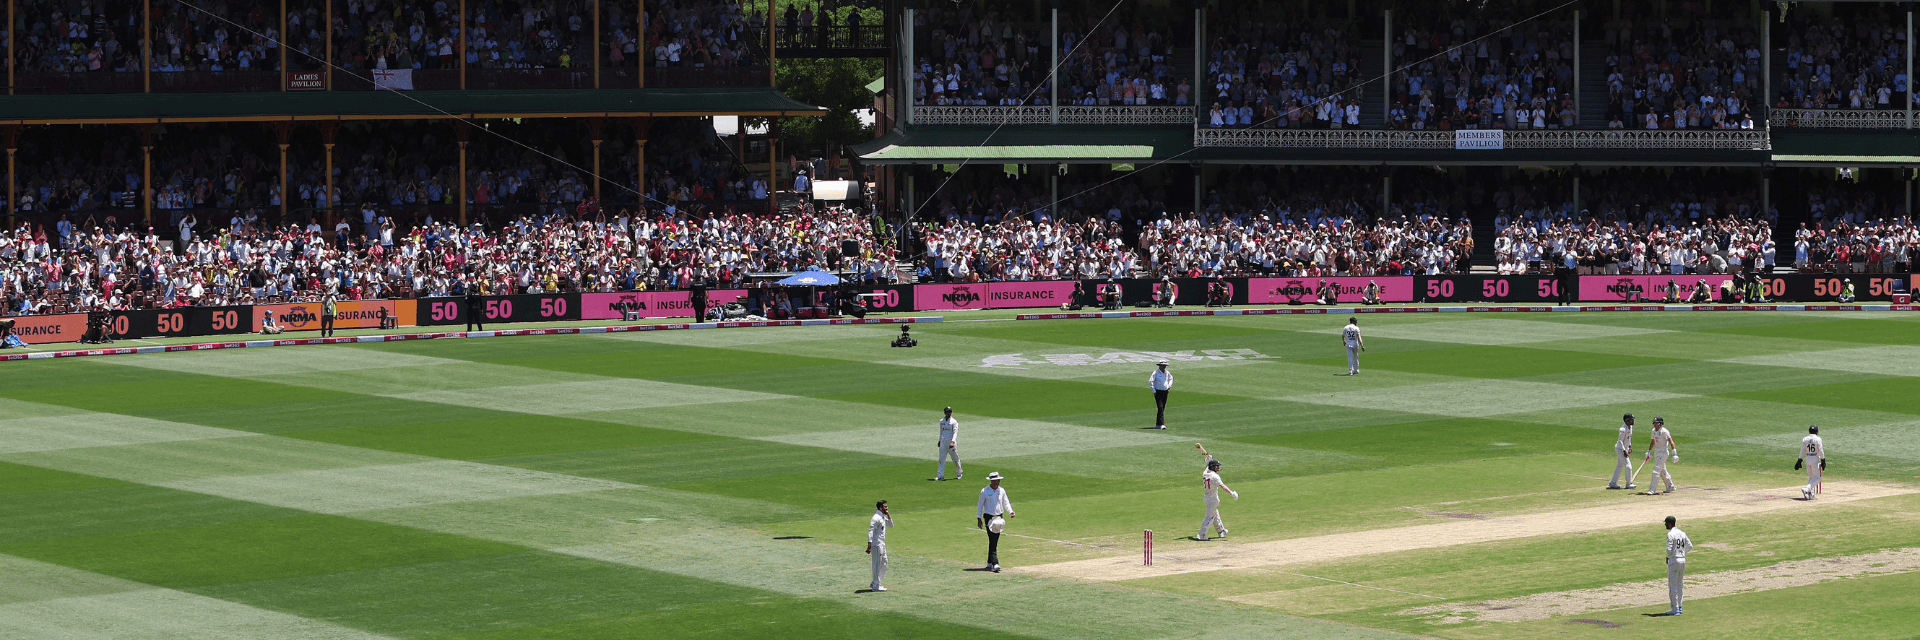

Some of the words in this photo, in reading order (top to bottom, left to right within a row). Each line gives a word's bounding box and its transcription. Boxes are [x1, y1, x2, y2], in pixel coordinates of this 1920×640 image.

[1277, 287, 1313, 295] NRMA
[1427, 279, 1455, 298] 50
[1482, 279, 1509, 298] 50
[1606, 285, 1644, 293] NRMA
[1654, 285, 1717, 293] INRAE
[1761, 278, 1786, 296] 50
[1814, 278, 1841, 296] 50
[1869, 278, 1894, 296] 50
[872, 289, 899, 308] 50
[942, 292, 980, 302] NRMA
[990, 290, 1054, 300] INSURANCE
[431, 301, 458, 321] 50
[486, 299, 512, 319] 50
[540, 298, 567, 317] 50
[609, 301, 646, 311] NRMA
[657, 300, 720, 310] INSURCE
[157, 312, 184, 333] 50
[212, 310, 238, 330] 50
[280, 312, 317, 323] NRMA
[10, 325, 62, 336] SURANCE
[1807, 444, 1815, 452] 16
[1677, 538, 1684, 549] 94
